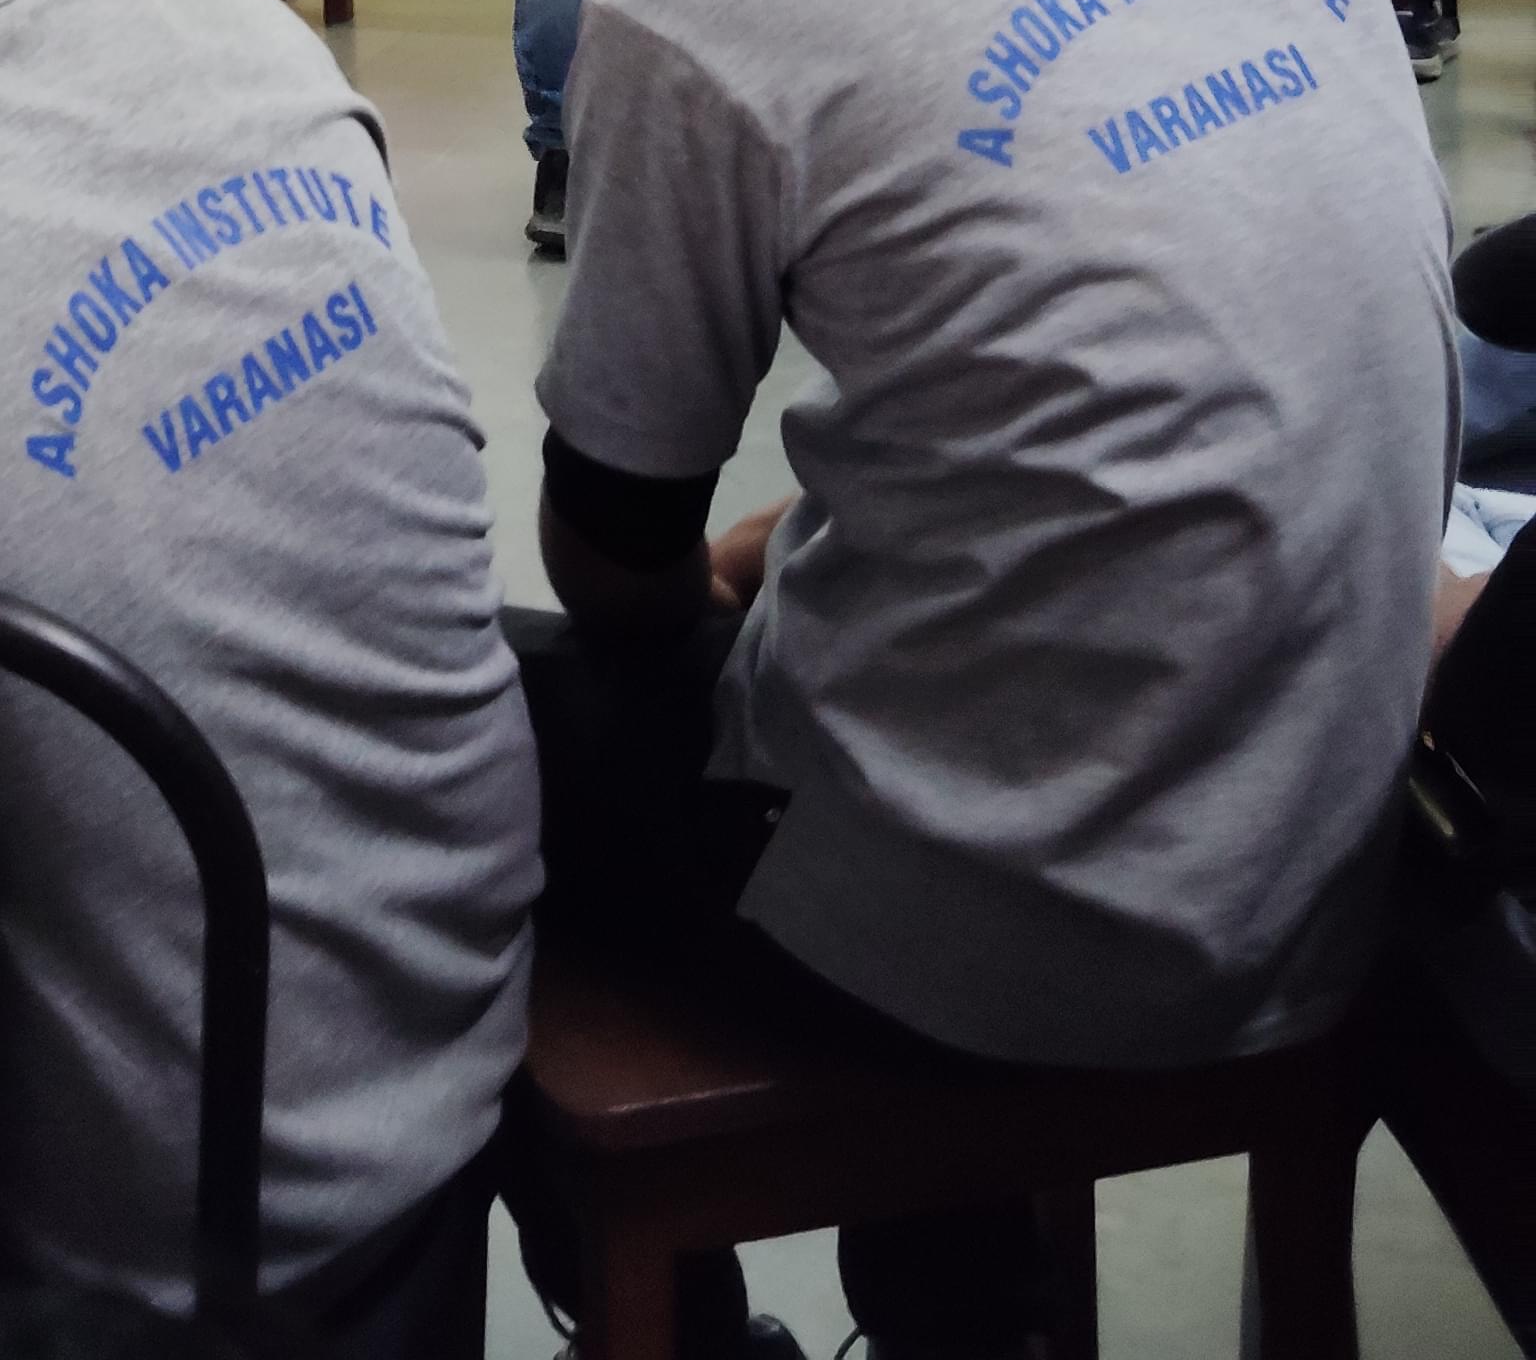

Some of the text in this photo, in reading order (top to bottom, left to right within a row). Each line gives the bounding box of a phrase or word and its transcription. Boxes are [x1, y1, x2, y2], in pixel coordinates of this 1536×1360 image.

[1087, 44, 1320, 175] VARANASI
[25, 166, 393, 480] ASHOKA INSTITUTE
[141, 281, 379, 475] VARANASI
